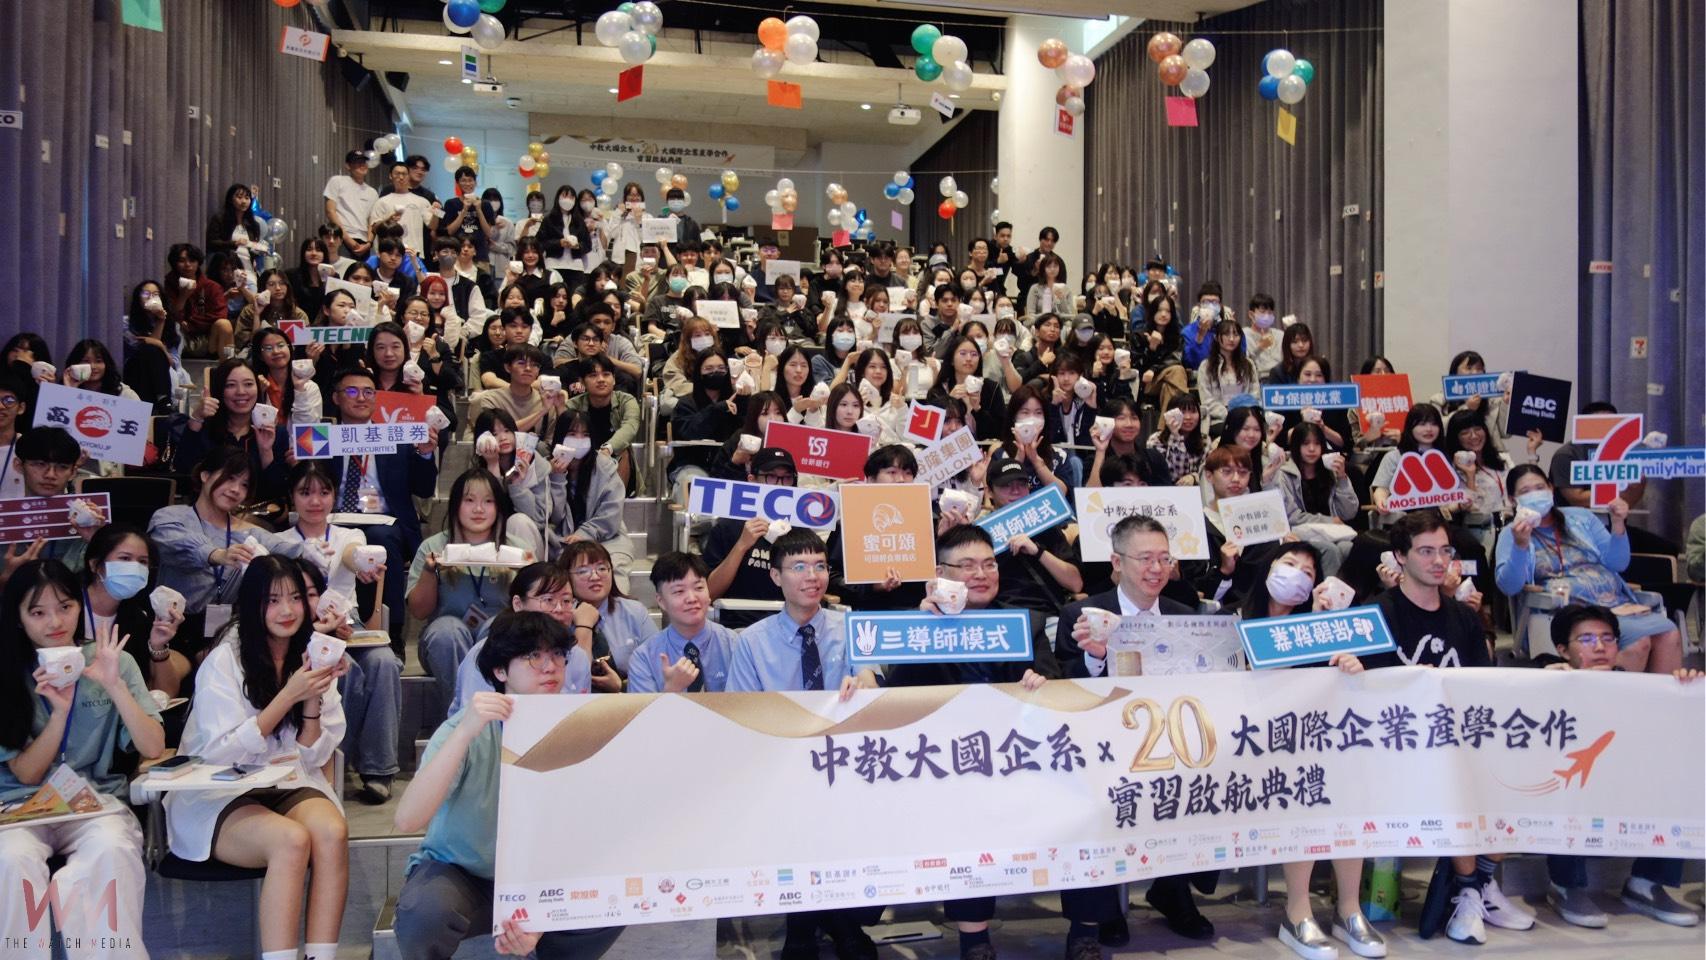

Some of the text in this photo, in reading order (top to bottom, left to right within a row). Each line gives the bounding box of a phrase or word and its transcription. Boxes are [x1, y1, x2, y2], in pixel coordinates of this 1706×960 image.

[1286, 390, 1342, 405] 保證就業
[1522, 395, 1557, 411] ABC
[341, 427, 428, 443] 凱基證券
[357, 446, 396, 454] SECURITIES
[801, 457, 830, 469] 台新銀行
[925, 453, 972, 486] YULON
[693, 478, 836, 527] TECO
[1389, 491, 1465, 510] MOS BURGER
[989, 499, 1058, 543] 導師模式
[863, 533, 916, 552] 蜜可頌
[880, 624, 1011, 653] 三導師模式
[811, 723, 1087, 788] 中教大國企系
[1121, 695, 1219, 772] 20
[1231, 703, 1578, 758] 大國際企業產學合作
[1107, 763, 1331, 829] 實習啟航典禮
[1386, 822, 1409, 830] TECO
[1420, 819, 1442, 827] ABC
[950, 866, 972, 875] ABC
[1005, 867, 1028, 876] TECO
[498, 894, 526, 902] TECO
[539, 888, 564, 897] ABC
[779, 891, 802, 900] ABC
